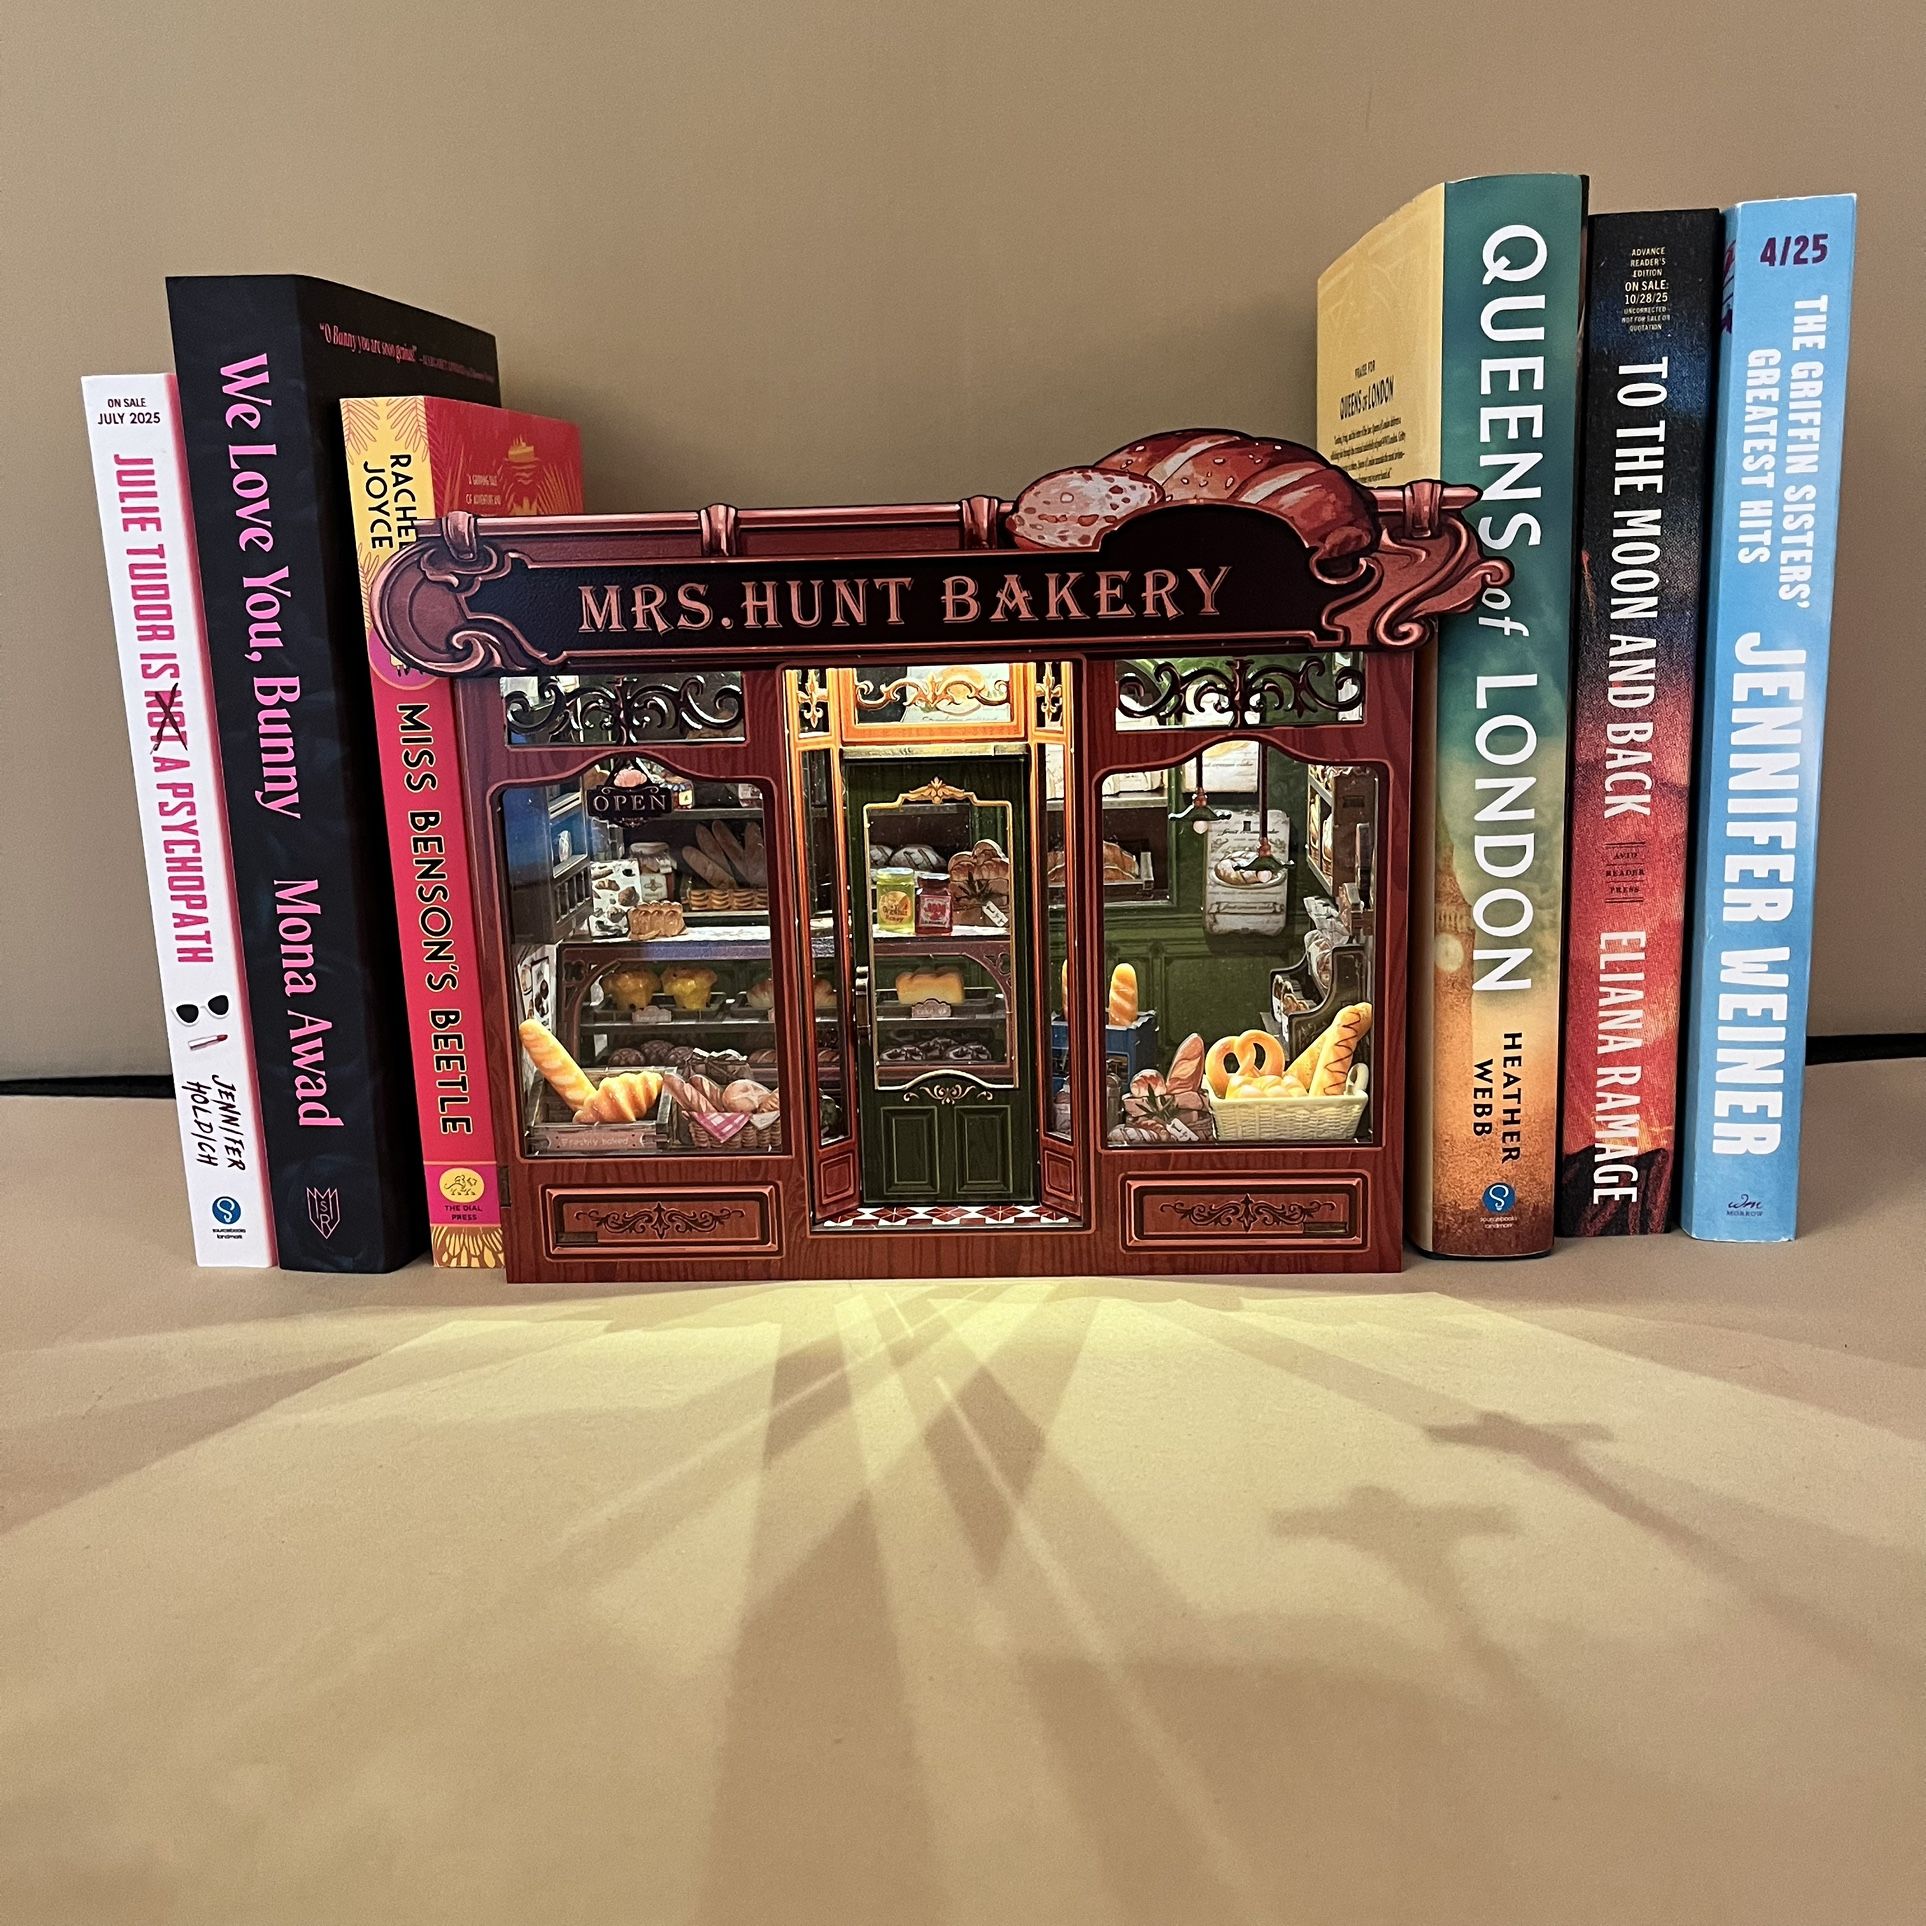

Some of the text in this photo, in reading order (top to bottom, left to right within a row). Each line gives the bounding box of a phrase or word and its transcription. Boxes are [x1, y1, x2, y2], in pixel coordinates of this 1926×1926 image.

[1625, 279, 1669, 292] ON SALE:
[1630, 257, 1666, 267] READER'S
[1631, 246, 1666, 256] ADVANCE
[1632, 268, 1663, 278] EDITION
[1760, 234, 1829, 267] 4/25
[1625, 292, 1668, 304] 10/28/25
[98, 412, 160, 424] JULY 2025
[107, 397, 146, 408] ON SALE
[1738, 349, 1782, 564] GREATEST HITS
[1779, 295, 1828, 609] THE GRIFFIN SISTERS'
[114, 453, 162, 532] JULIE
[363, 461, 394, 549] JOYCE
[126, 543, 175, 641] TUDOR
[220, 353, 301, 819] We Love You, Bunny
[942, 564, 1232, 625] BAKERY
[1473, 224, 1548, 992] QUEENS of LONDON
[1604, 357, 1669, 819] TO THE MOON AND BACK
[139, 653, 180, 680] IS
[152, 756, 191, 774] A
[592, 794, 667, 813] OPEN
[157, 783, 213, 963] PSYCHOPATH
[1605, 869, 1645, 877] READER
[1713, 632, 1807, 1155] JENNIFER WEINER
[397, 703, 473, 1136] MISS BENSON'S BEETLE
[273, 879, 345, 1127] Mona Awad
[1473, 1058, 1494, 1137] WEBB
[1502, 1032, 1523, 1165] HEATHER
[1592, 927, 1646, 1205] ELIANA RAMAGE
[181, 1081, 219, 1168] HOLDICH
[211, 1074, 246, 1172] JENNIFER
[444, 1204, 460, 1212] THE
